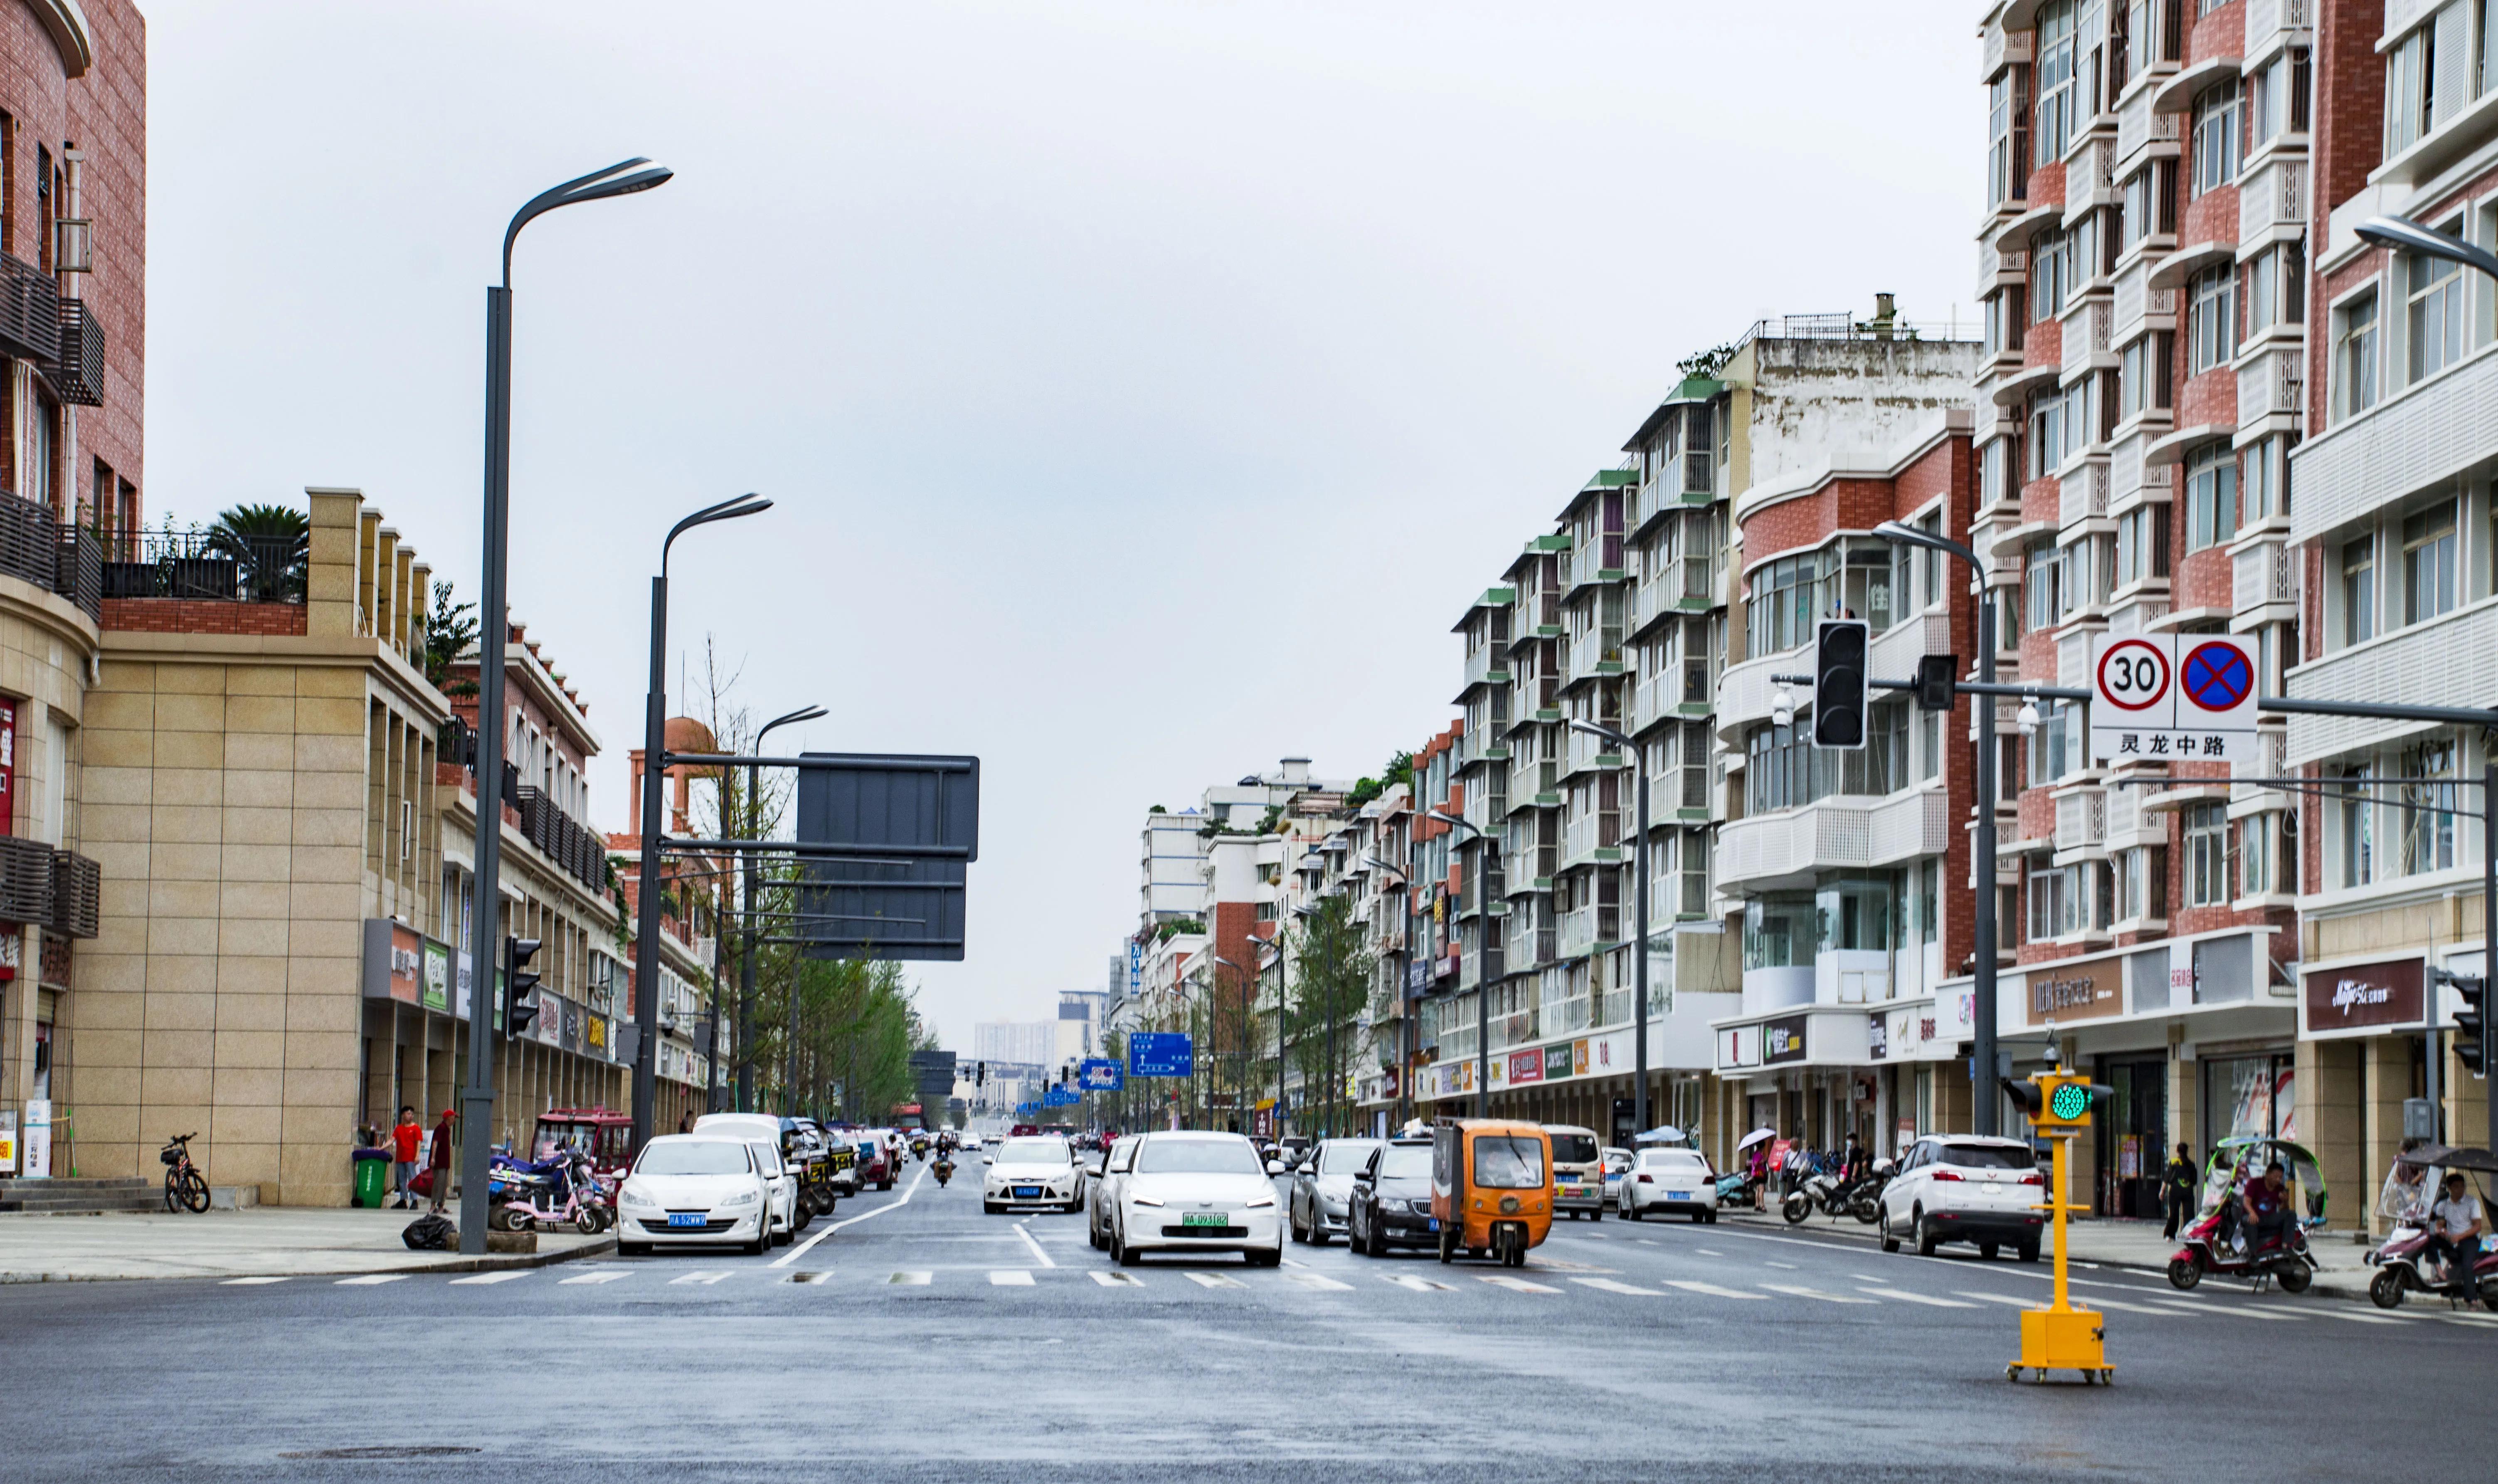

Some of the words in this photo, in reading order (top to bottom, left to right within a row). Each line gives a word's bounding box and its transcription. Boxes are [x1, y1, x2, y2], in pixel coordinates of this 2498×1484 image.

[2113, 657, 2155, 691] 30
[2120, 733, 2224, 756] 灵龙中路
